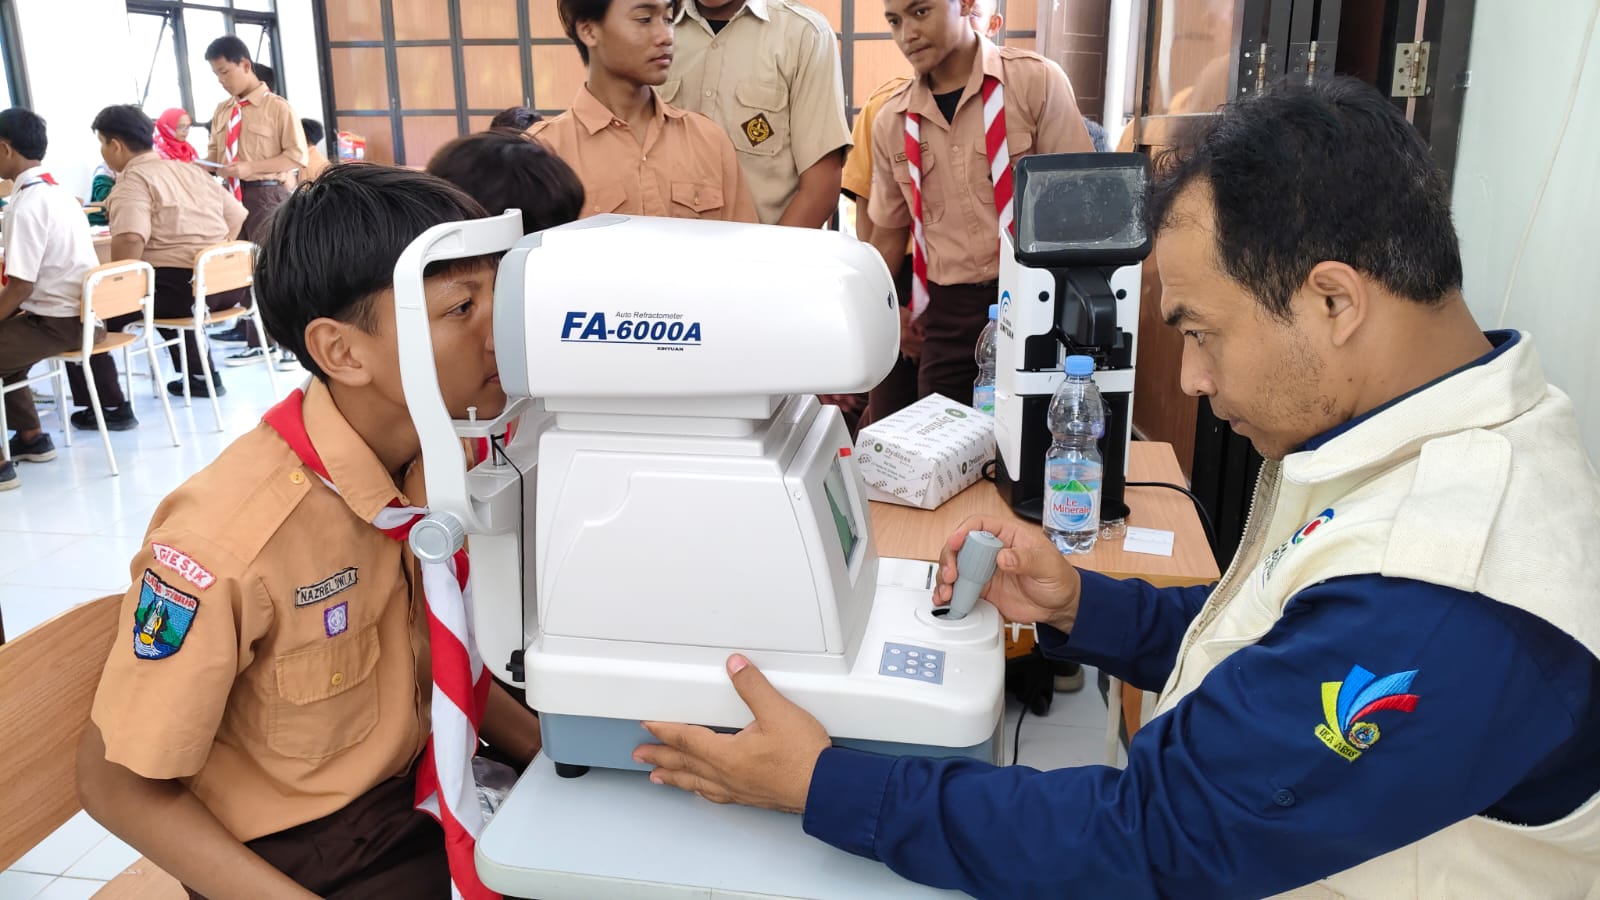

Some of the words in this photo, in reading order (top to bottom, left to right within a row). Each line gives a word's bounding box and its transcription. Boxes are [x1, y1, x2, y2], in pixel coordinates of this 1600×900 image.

[616, 311, 632, 319] Auto
[633, 311, 684, 320] Refractometer
[561, 311, 702, 342] FA-6000A
[885, 447, 911, 463] Dydines
[1066, 497, 1077, 506] Le
[300, 581, 334, 603] NAZREL
